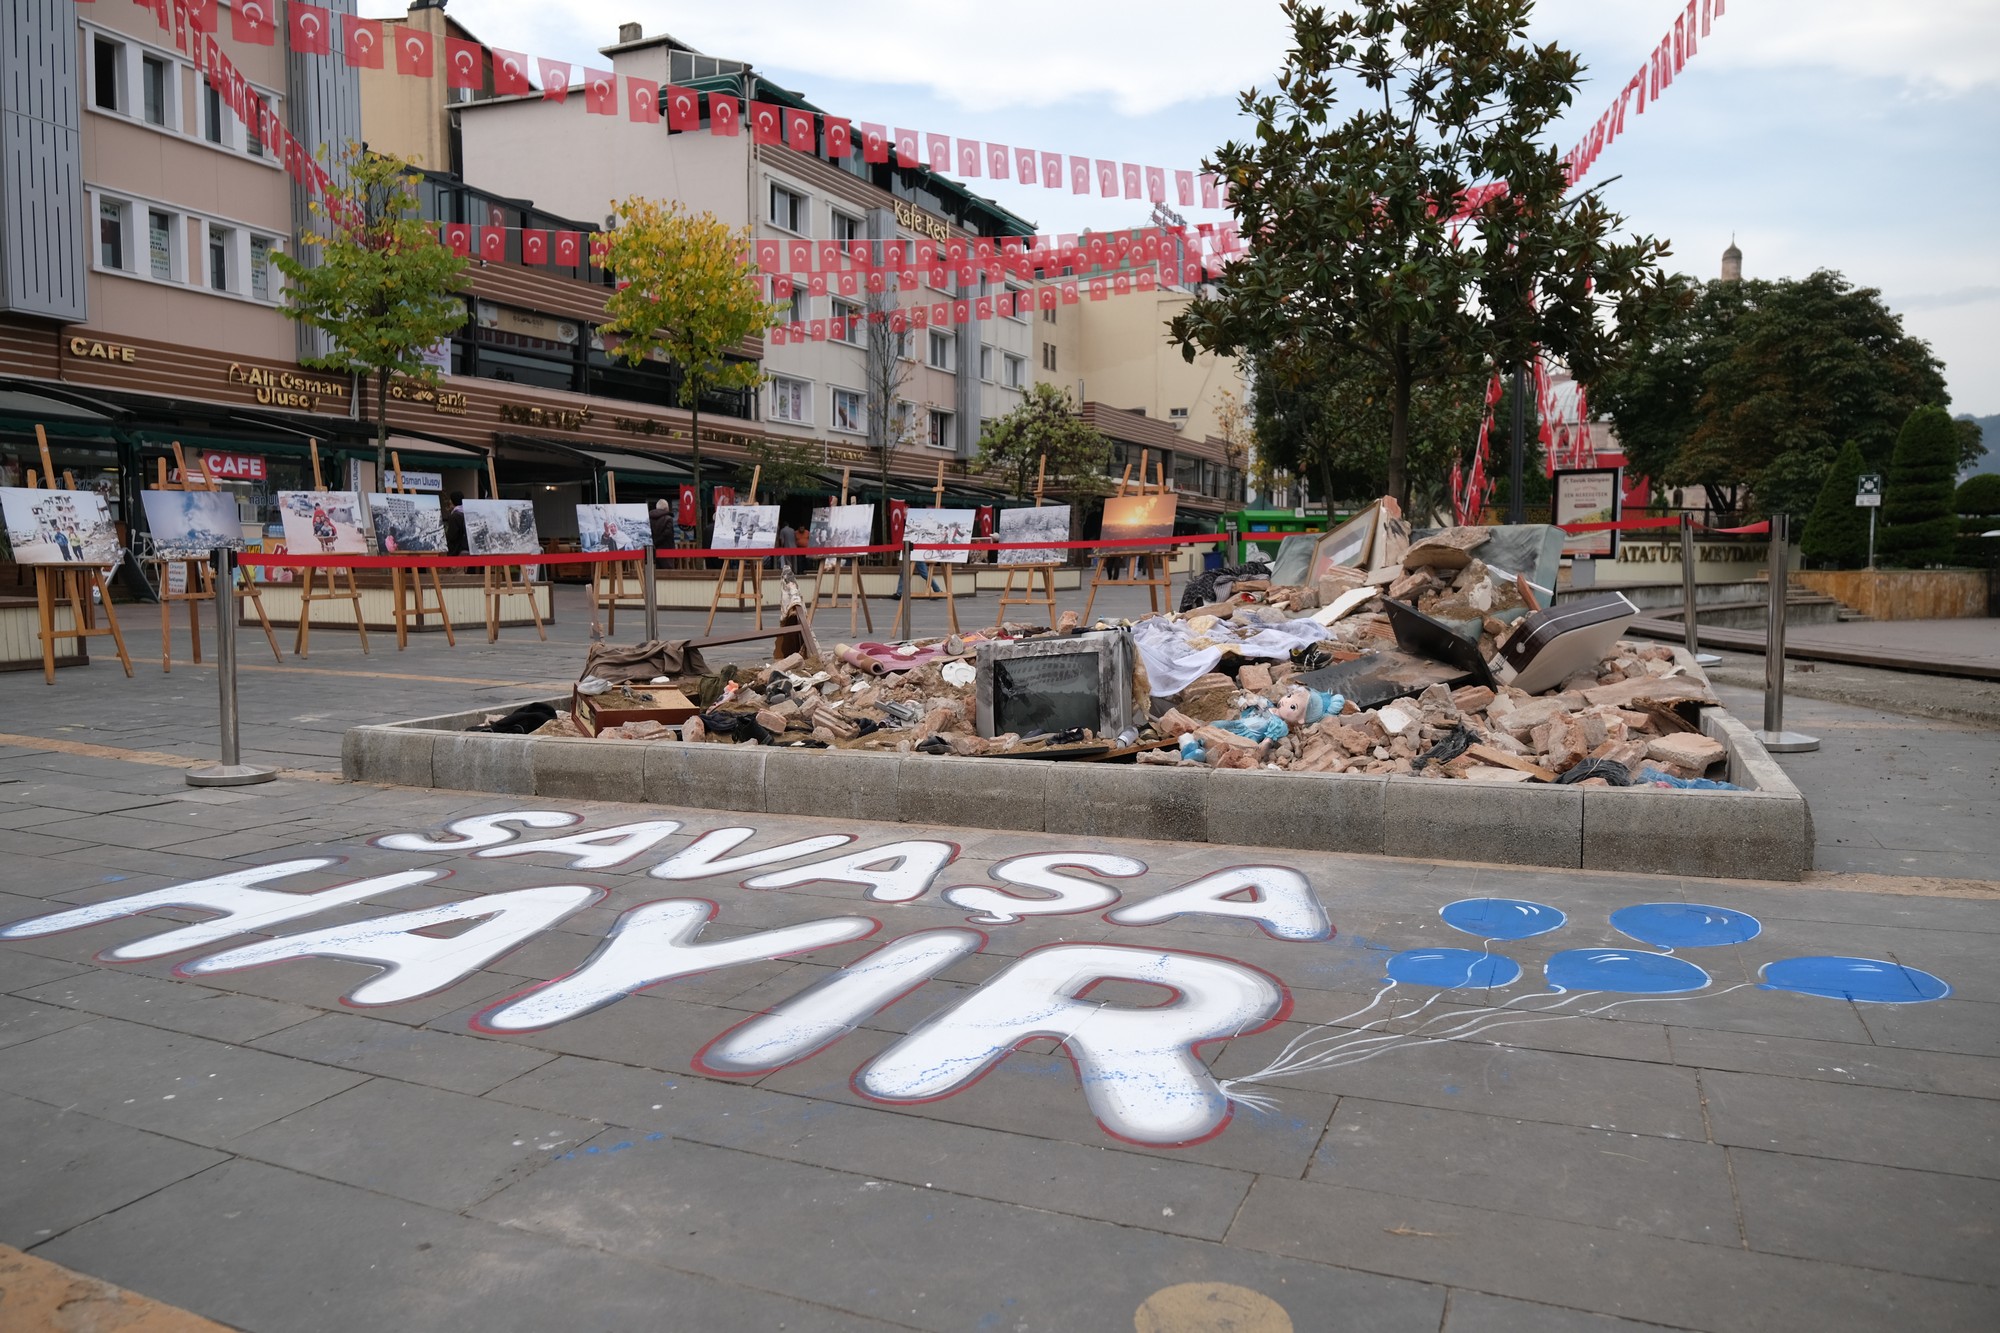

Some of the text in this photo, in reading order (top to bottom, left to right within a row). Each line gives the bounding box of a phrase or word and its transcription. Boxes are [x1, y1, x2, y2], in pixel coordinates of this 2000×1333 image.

[894, 199, 950, 243] Kafe Rest
[70, 336, 135, 363] CAFE
[249, 367, 343, 397] Ali Osman
[256, 386, 321, 413] Ulusoy
[208, 454, 262, 476] CAFE
[422, 477, 441, 488] Ulusoy
[1617, 542, 1769, 563] ATATÜR MEYDANI
[368, 811, 1333, 941] SAVAŞA
[0, 857, 1292, 1146] HAYIR
